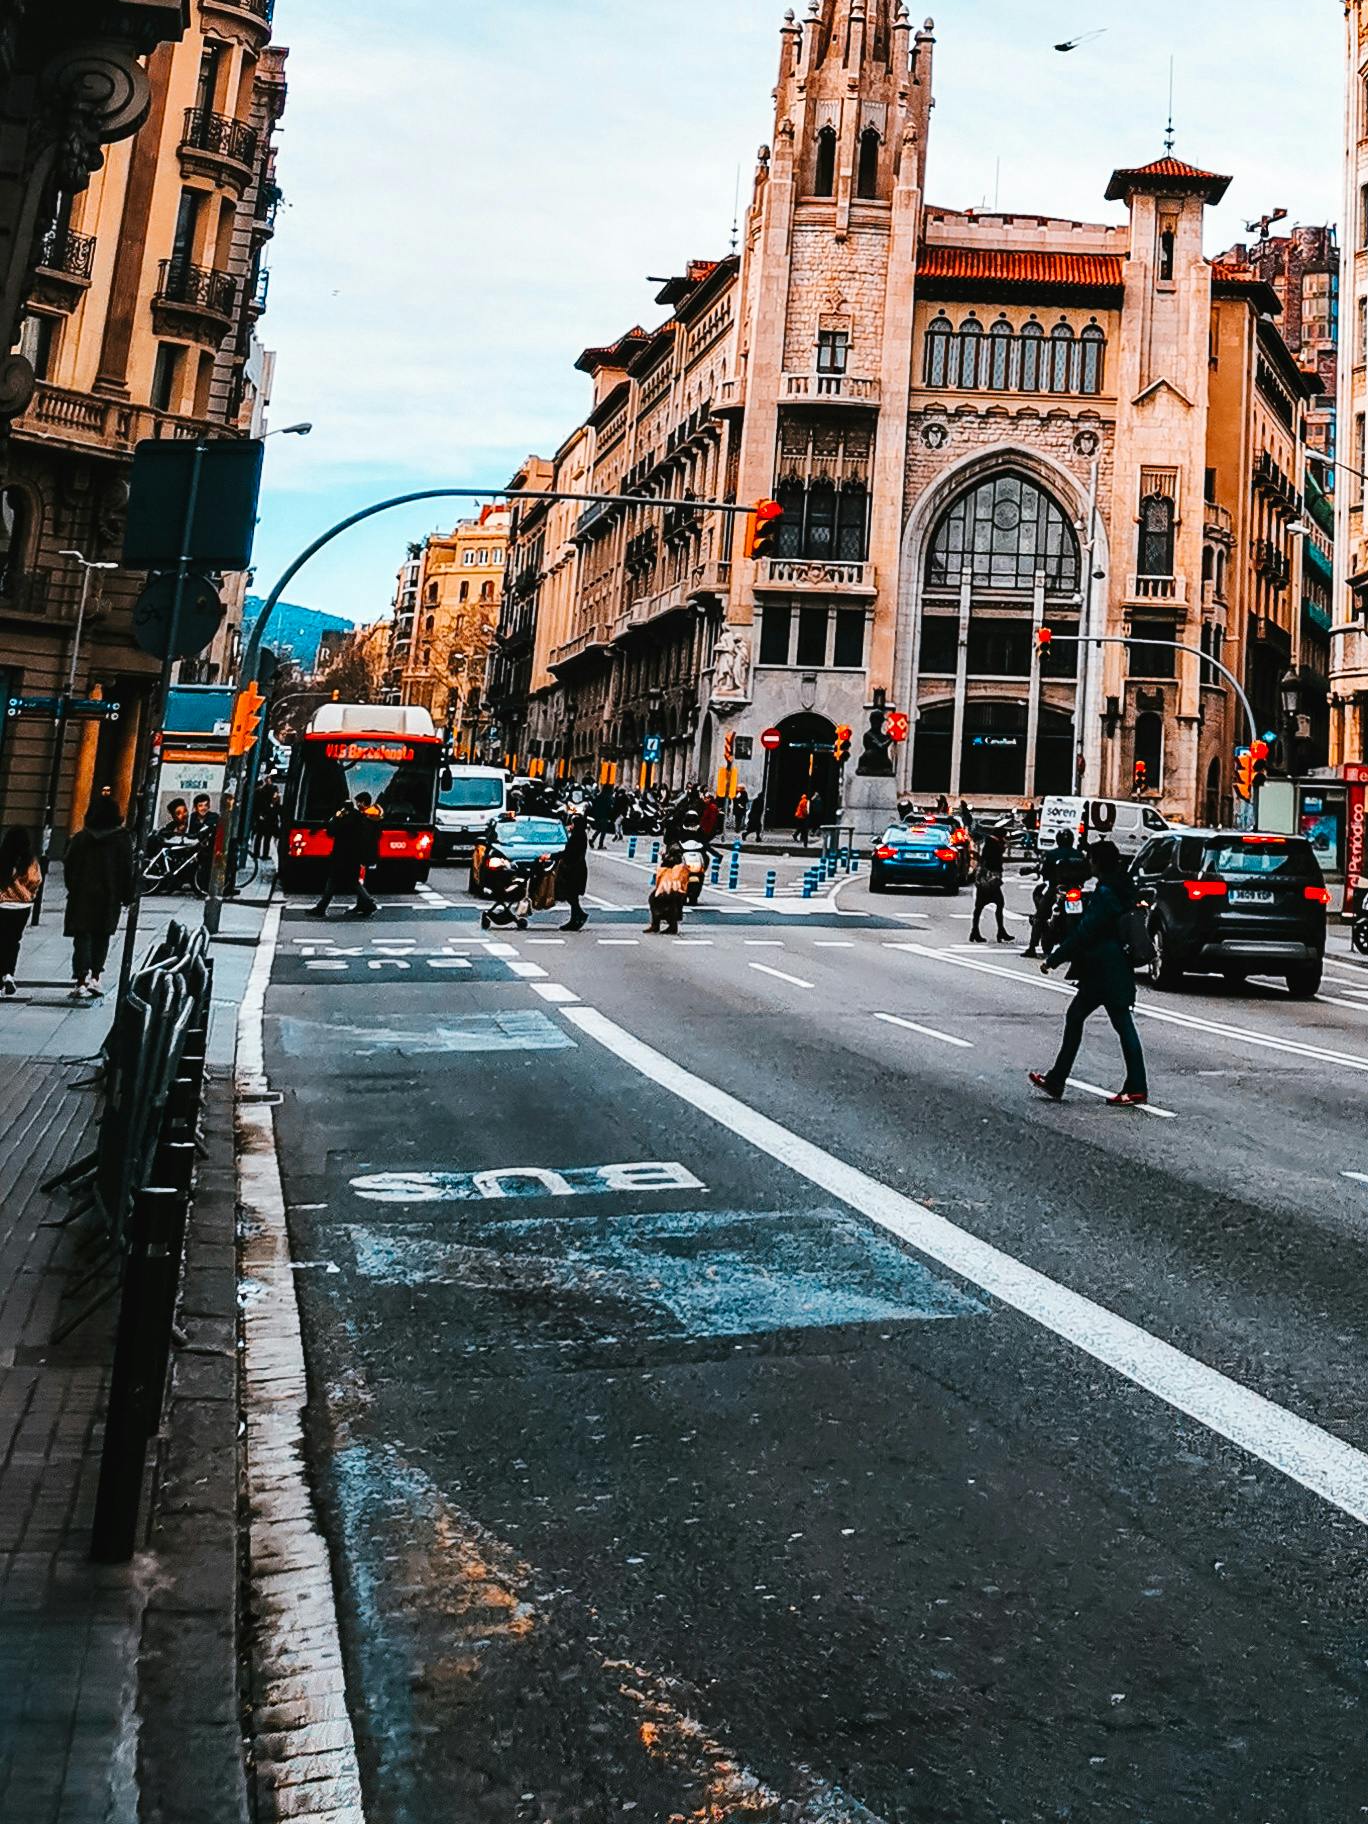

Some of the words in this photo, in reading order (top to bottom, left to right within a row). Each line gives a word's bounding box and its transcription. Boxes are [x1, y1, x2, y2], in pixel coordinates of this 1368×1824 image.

[348, 743, 414, 760] Barceloneta
[1348, 804, 1364, 872] Periódico
[301, 946, 470, 956] TAXI
[304, 958, 473, 970] BUS
[349, 1161, 706, 1202] BUS
